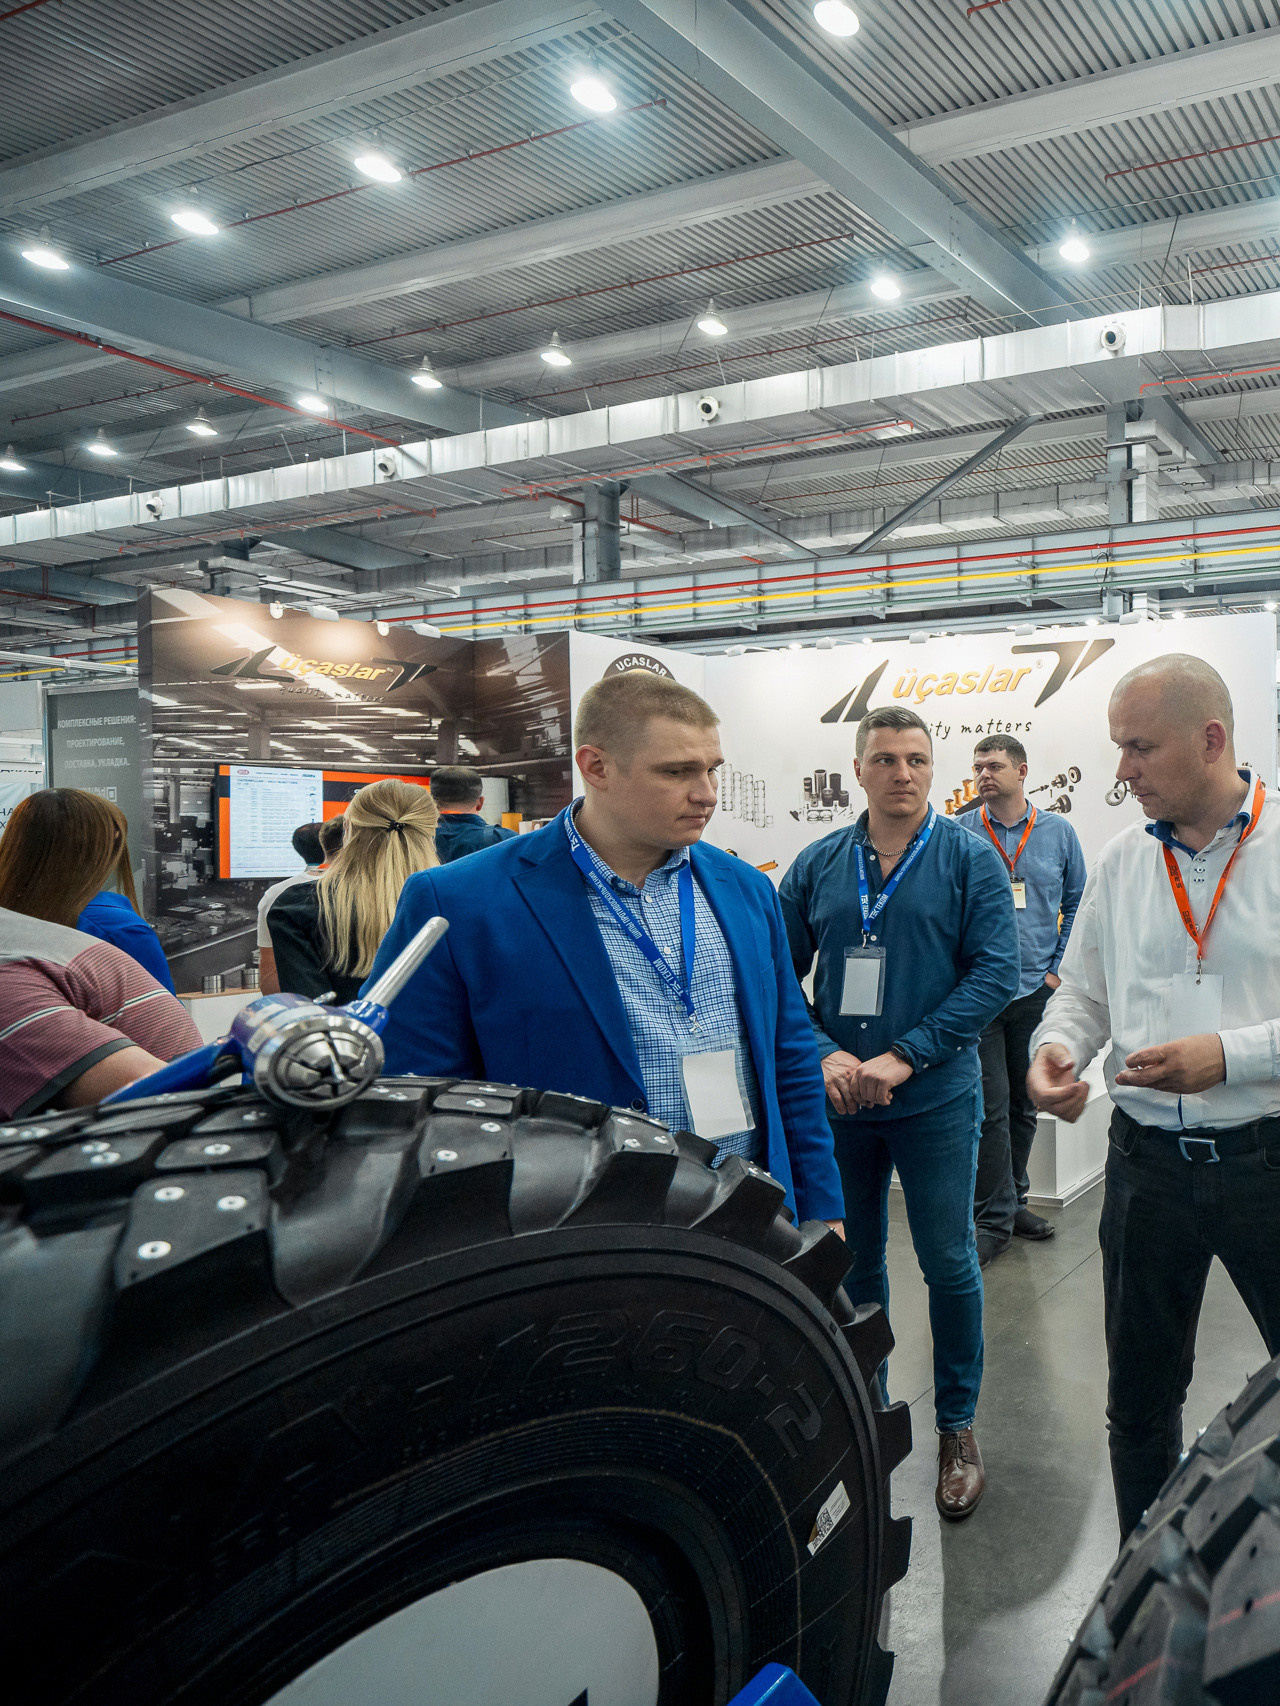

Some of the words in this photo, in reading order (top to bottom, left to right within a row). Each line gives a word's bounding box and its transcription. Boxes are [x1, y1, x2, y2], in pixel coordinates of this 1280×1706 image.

[279, 653, 387, 681] üçaslar
[892, 664, 1032, 704] üçaslar
[58, 717, 102, 729] КОМПЛЕКСНЫЕ
[104, 715, 136, 725] РЕШЕНИЯ:
[961, 718, 1032, 735] matters
